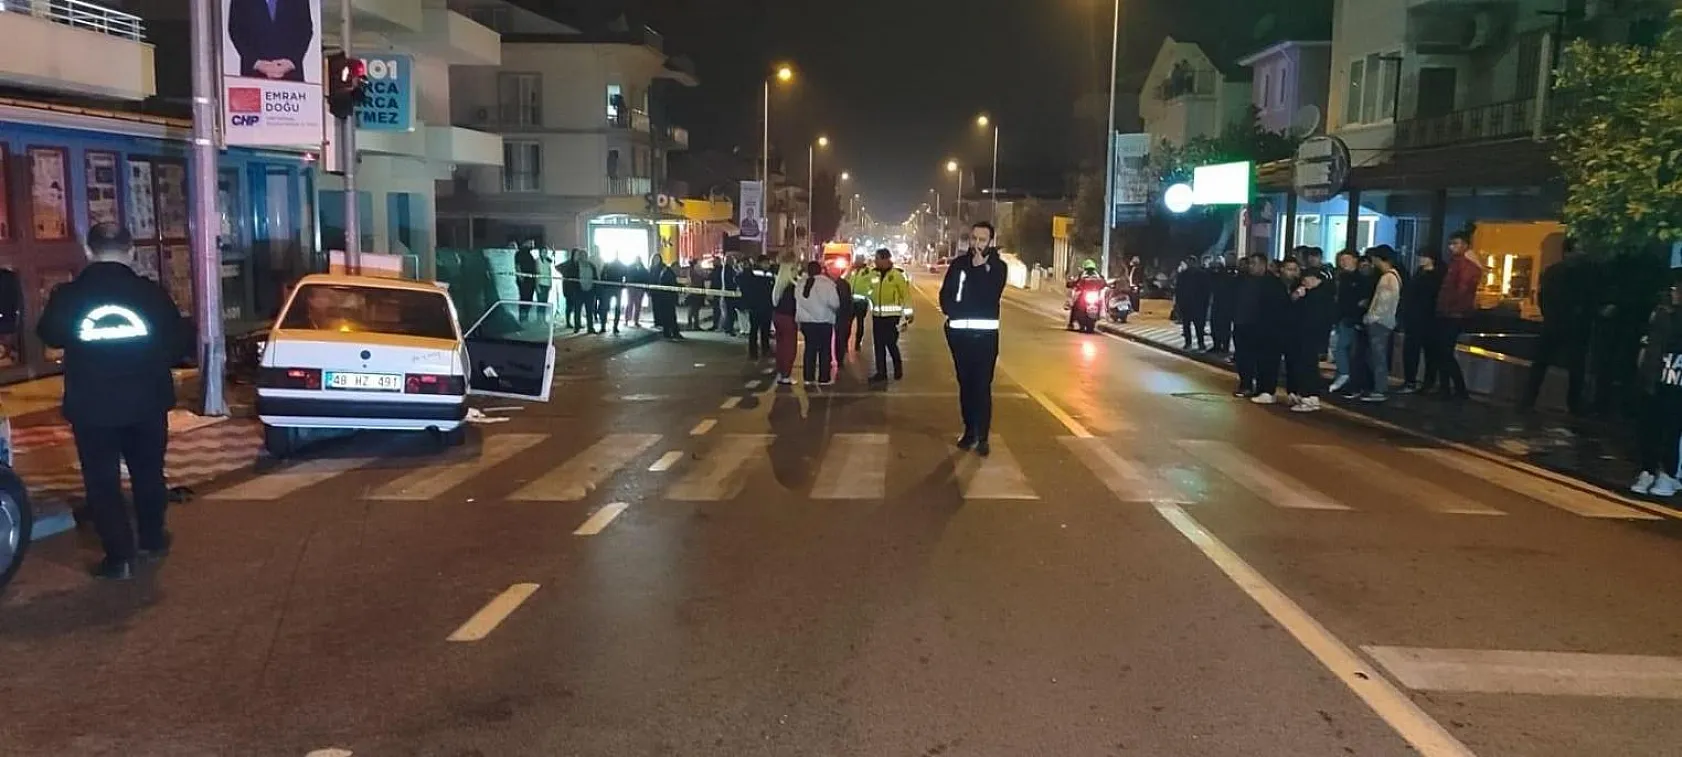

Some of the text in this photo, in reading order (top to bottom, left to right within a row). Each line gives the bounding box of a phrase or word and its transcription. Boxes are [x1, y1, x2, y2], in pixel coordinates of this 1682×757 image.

[265, 91, 307, 101] EMRAH
[265, 102, 300, 112] DOĞU
[231, 115, 260, 126] CHP
[333, 374, 397, 388] 48 HZ 491
